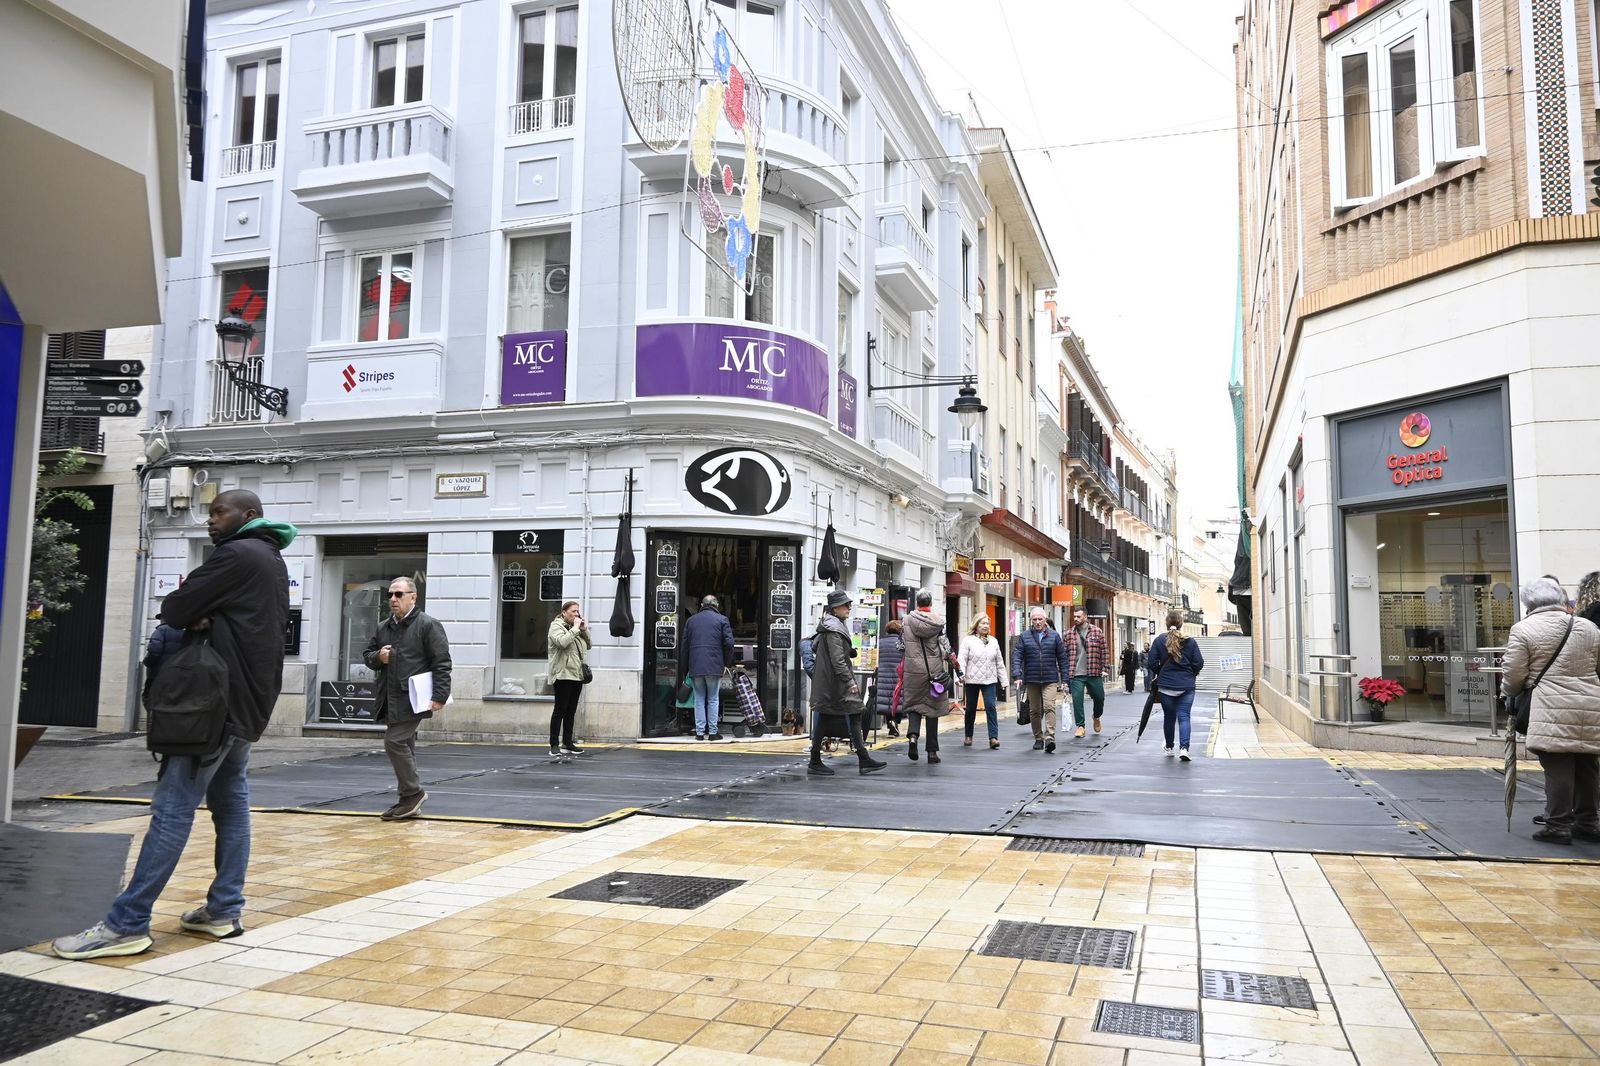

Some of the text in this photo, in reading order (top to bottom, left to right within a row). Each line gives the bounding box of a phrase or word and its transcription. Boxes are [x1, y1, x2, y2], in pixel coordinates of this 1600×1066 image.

[358, 371, 395, 384] Stripes
[746, 383, 773, 392] ABOGADOS
[1386, 445, 1448, 469] General
[1391, 465, 1442, 487] Optica
[975, 572, 1010, 580] TABACOS
[1467, 682, 1479, 690] TUS
